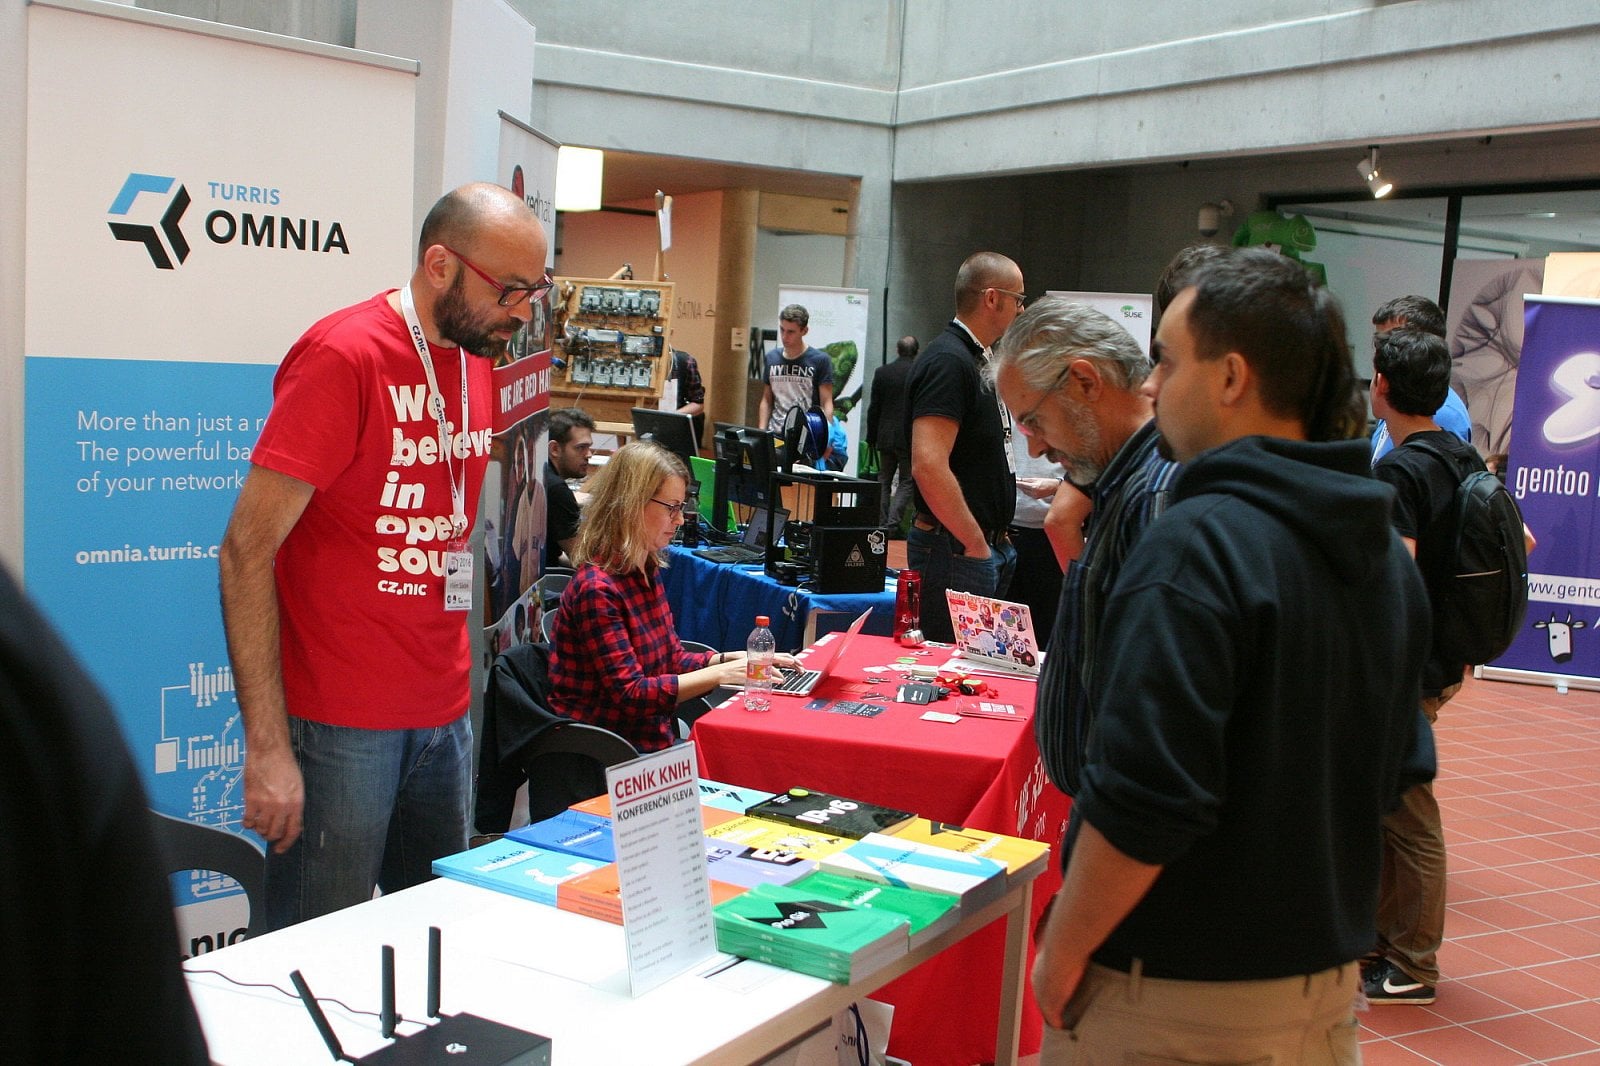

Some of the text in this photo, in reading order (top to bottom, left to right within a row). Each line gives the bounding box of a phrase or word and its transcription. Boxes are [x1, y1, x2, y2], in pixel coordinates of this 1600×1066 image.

[207, 181, 281, 206] TURRIS
[204, 208, 351, 256] OMNIA
[1124, 311, 1143, 319] SUSE
[500, 384, 512, 414] WE
[512, 378, 524, 408] ARE
[524, 373, 537, 401] RED
[77, 410, 137, 431] More
[142, 410, 190, 431] than
[194, 411, 233, 437] just
[238, 417, 249, 431] a
[76, 440, 119, 461] The
[127, 440, 220, 467] powerful
[390, 421, 493, 467] believe
[77, 469, 243, 497] of your network
[380, 471, 425, 509] in
[1514, 463, 1590, 500] gentoo
[377, 579, 428, 596] cz.nic
[614, 759, 692, 799] CENÍK KNIH
[617, 793, 671, 822] KONFERENČNÍ
[672, 787, 694, 803] SLEVA
[795, 799, 859, 824] IPv6
